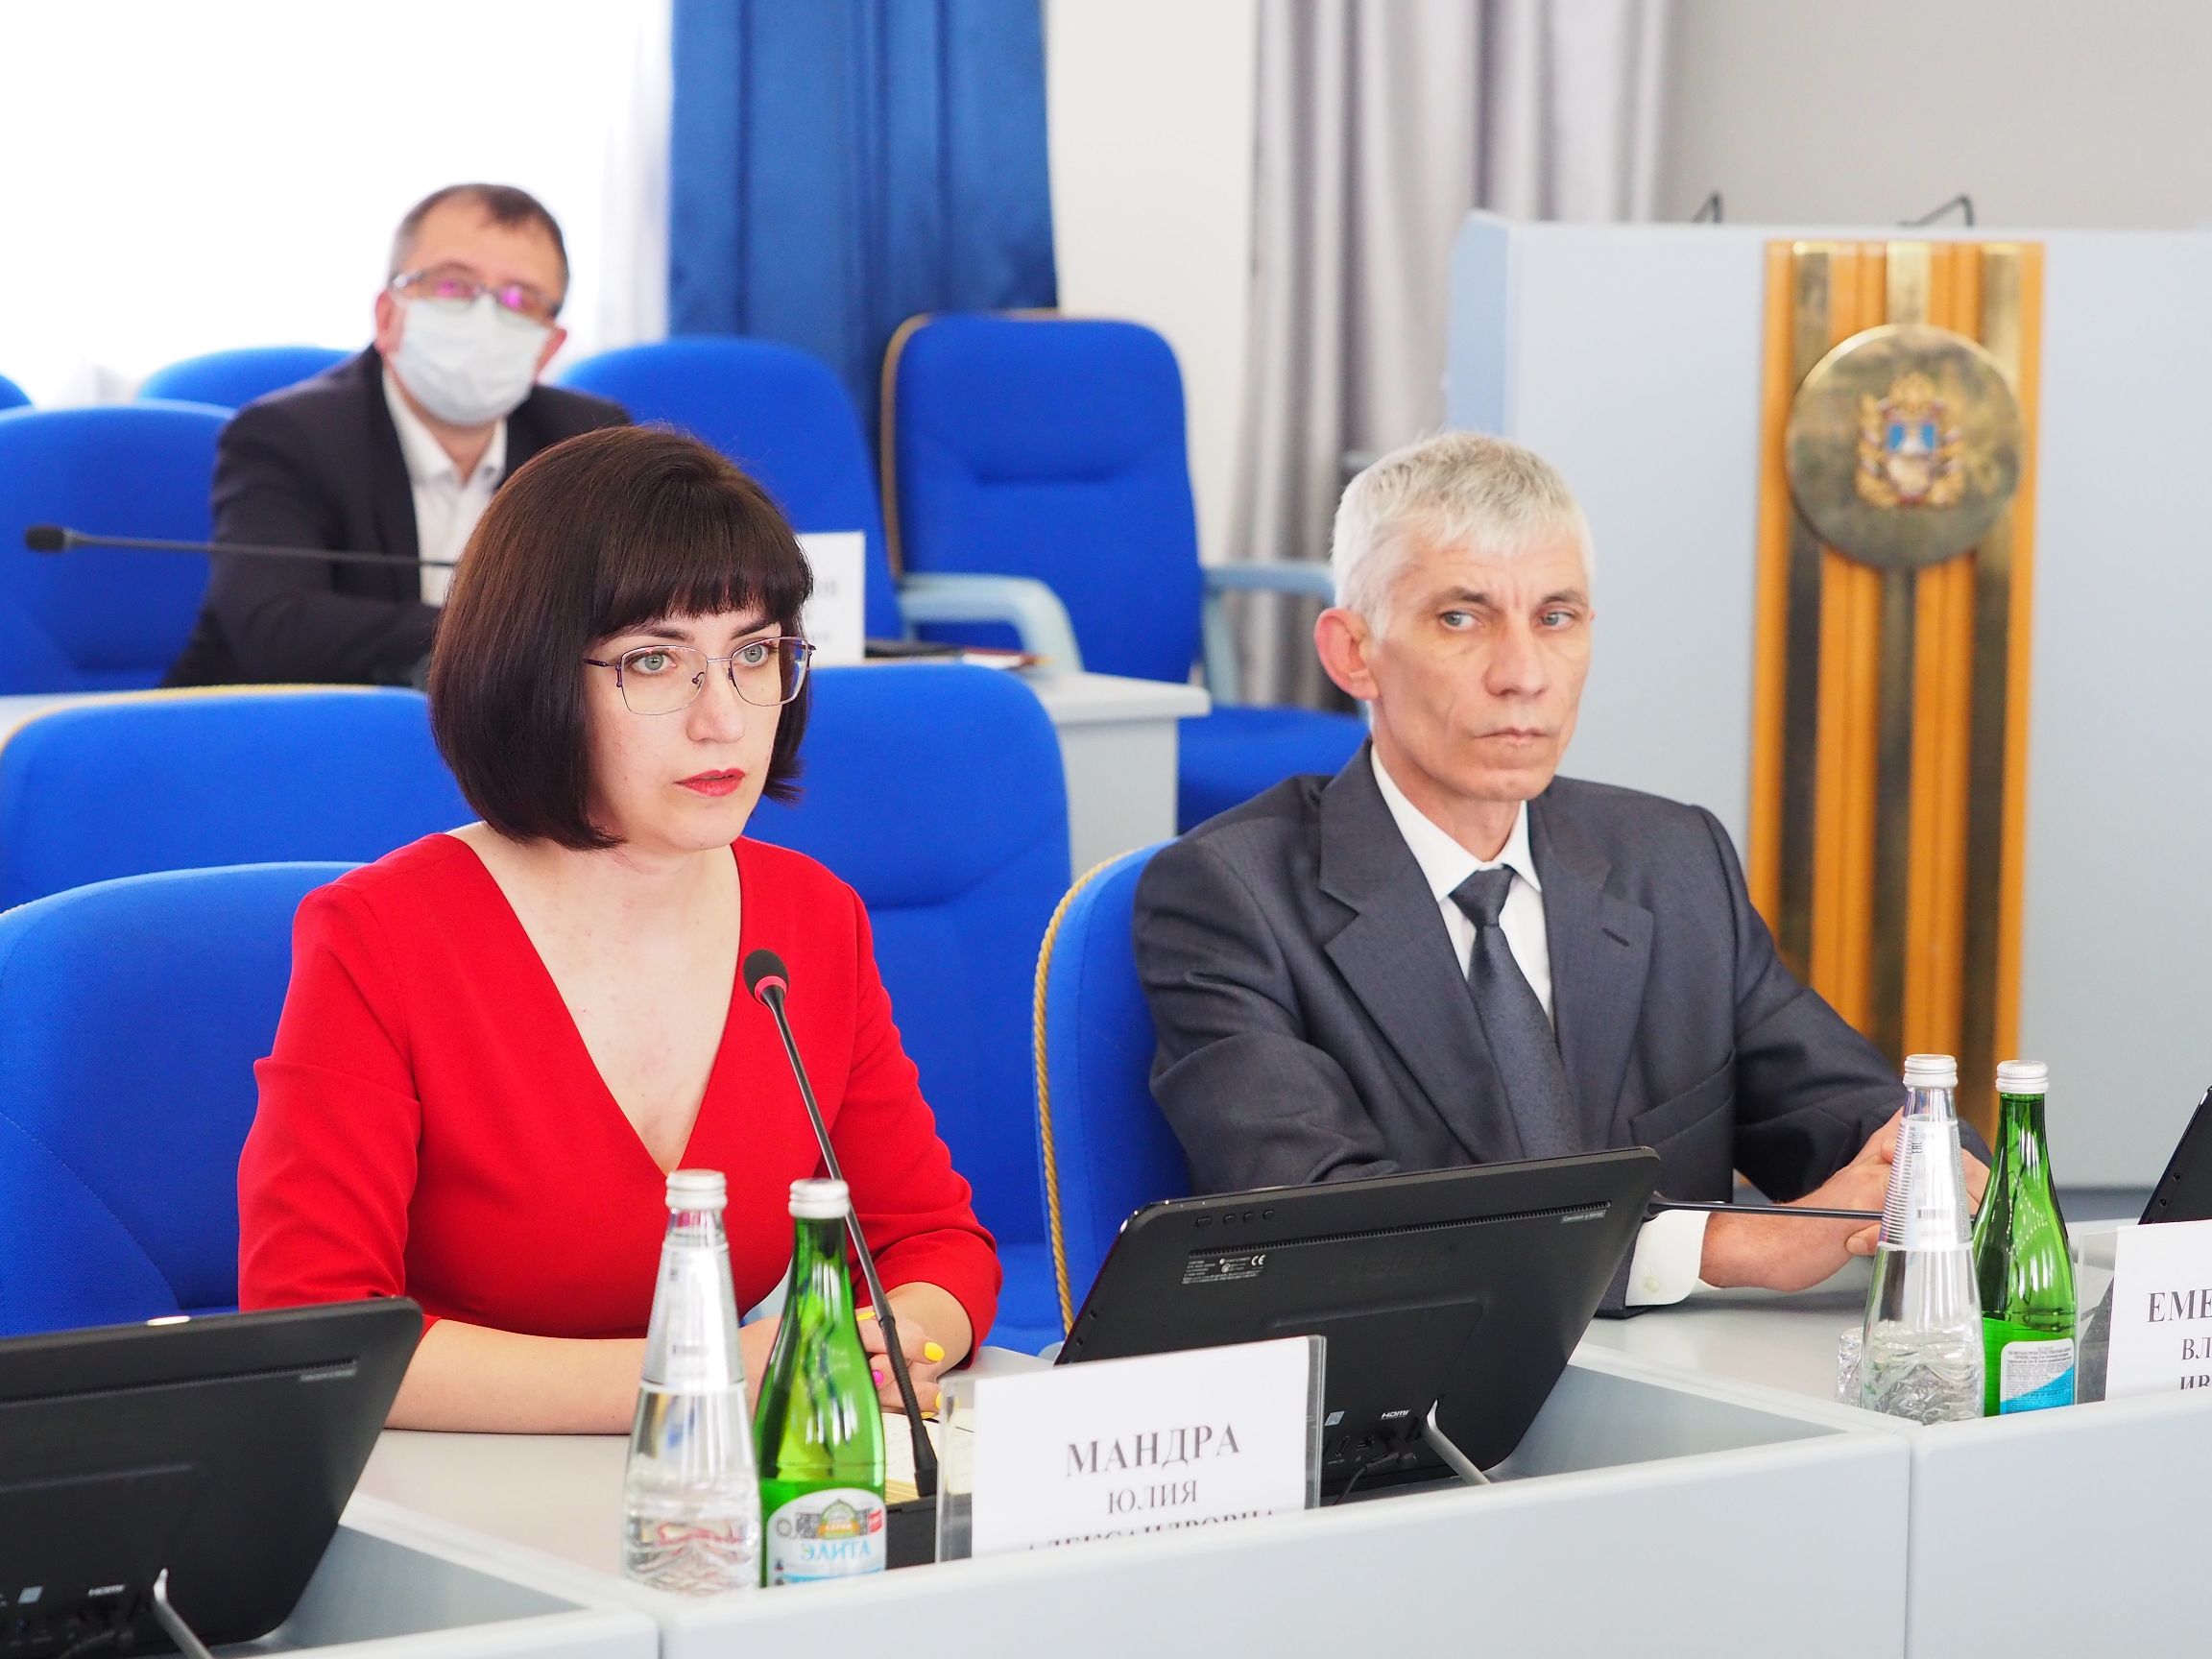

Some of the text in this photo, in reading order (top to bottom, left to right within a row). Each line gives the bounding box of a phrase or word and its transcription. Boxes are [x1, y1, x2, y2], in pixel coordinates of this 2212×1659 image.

[2181, 1336, 2211, 1360] ВЛ
[1066, 1422, 1240, 1478] МАНДРА
[1108, 1479, 1198, 1515] ЮЛИЯ
